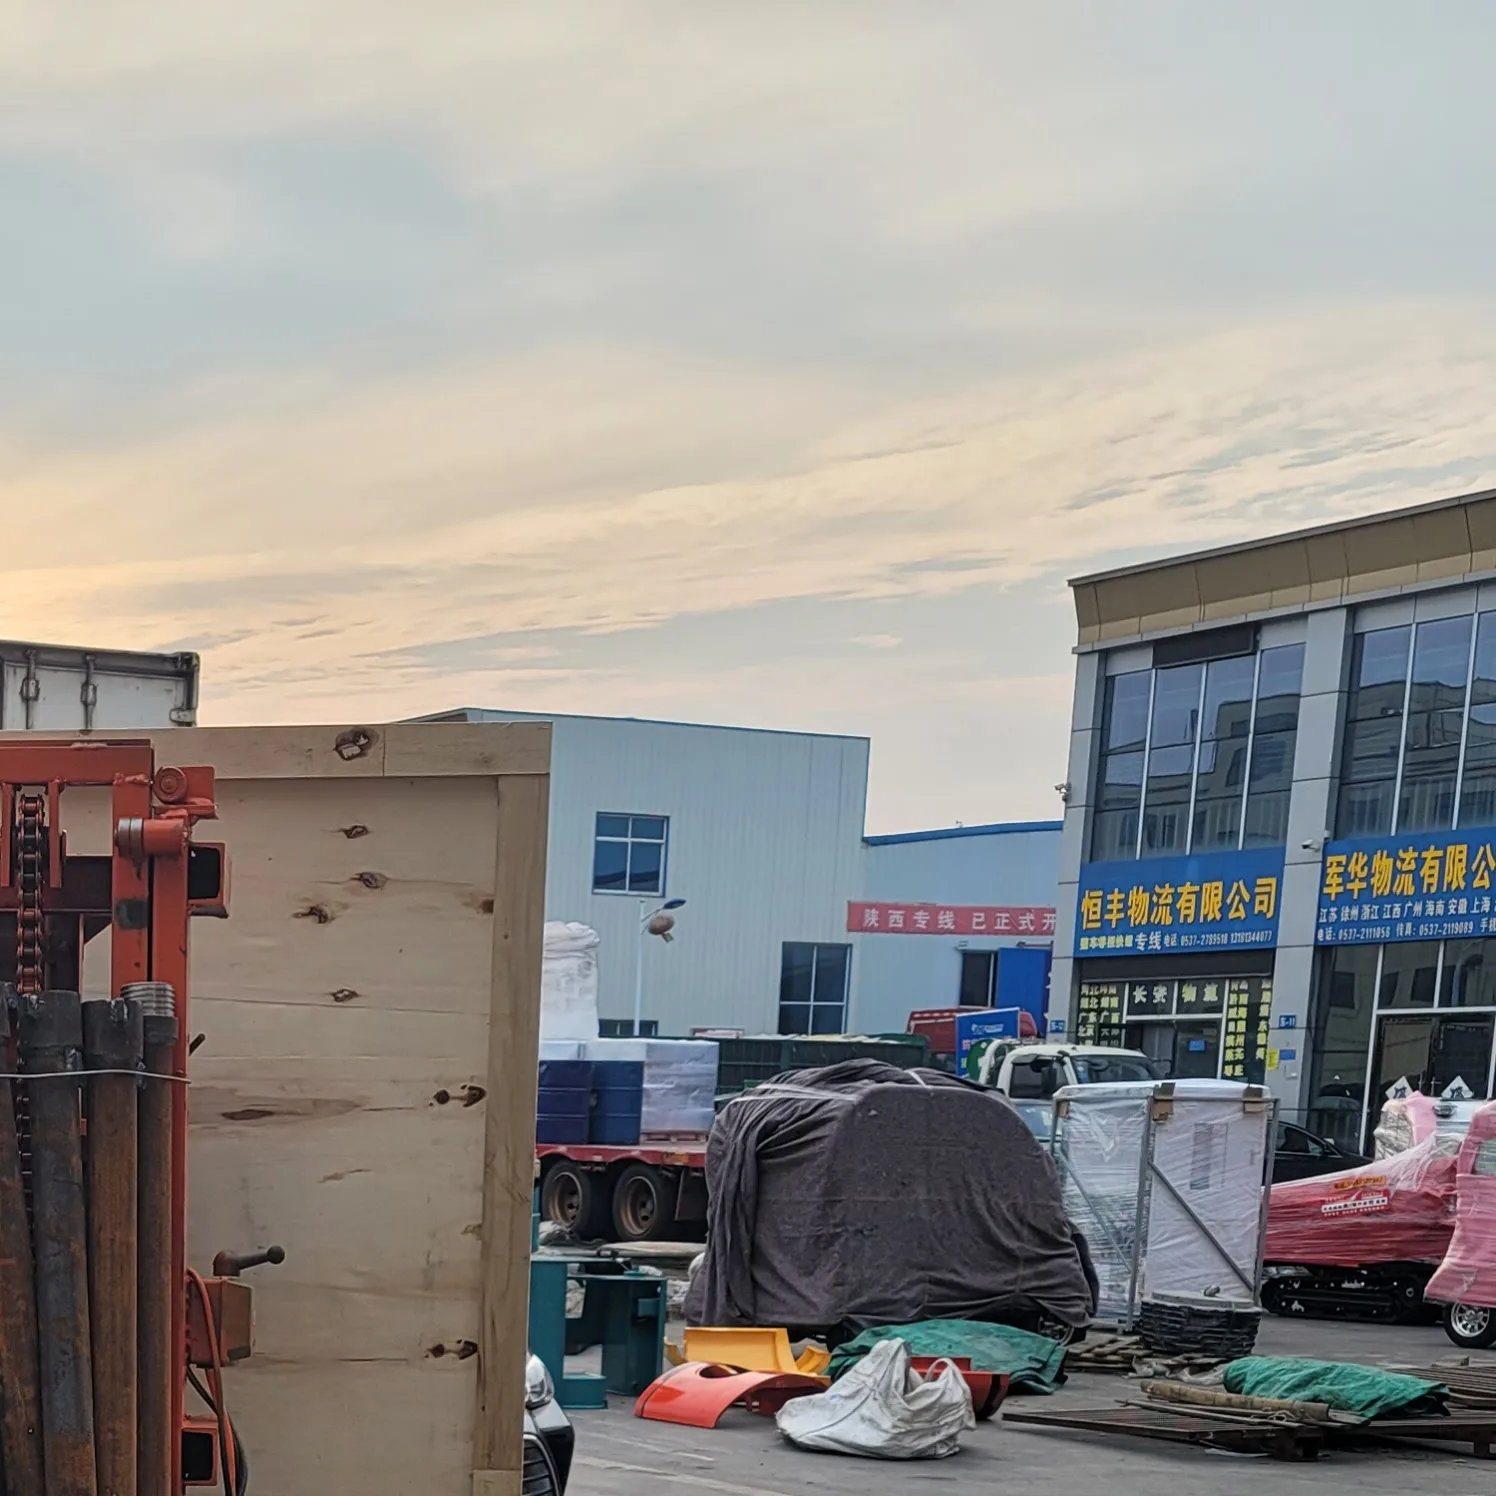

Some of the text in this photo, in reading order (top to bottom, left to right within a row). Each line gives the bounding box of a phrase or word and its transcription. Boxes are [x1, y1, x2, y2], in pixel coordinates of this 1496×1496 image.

[1323, 843, 1496, 901] 军华物流有限公
[1081, 877, 1278, 930] 恒丰物流有限公司
[1319, 907, 1338, 923] 江苏
[1383, 903, 1402, 919] 江西
[1404, 901, 1422, 918] 广州
[1425, 899, 1445, 916] 海南
[1470, 896, 1491, 914] 上海
[863, 908, 955, 929] 陕西专线
[1135, 931, 1161, 951] 专线
